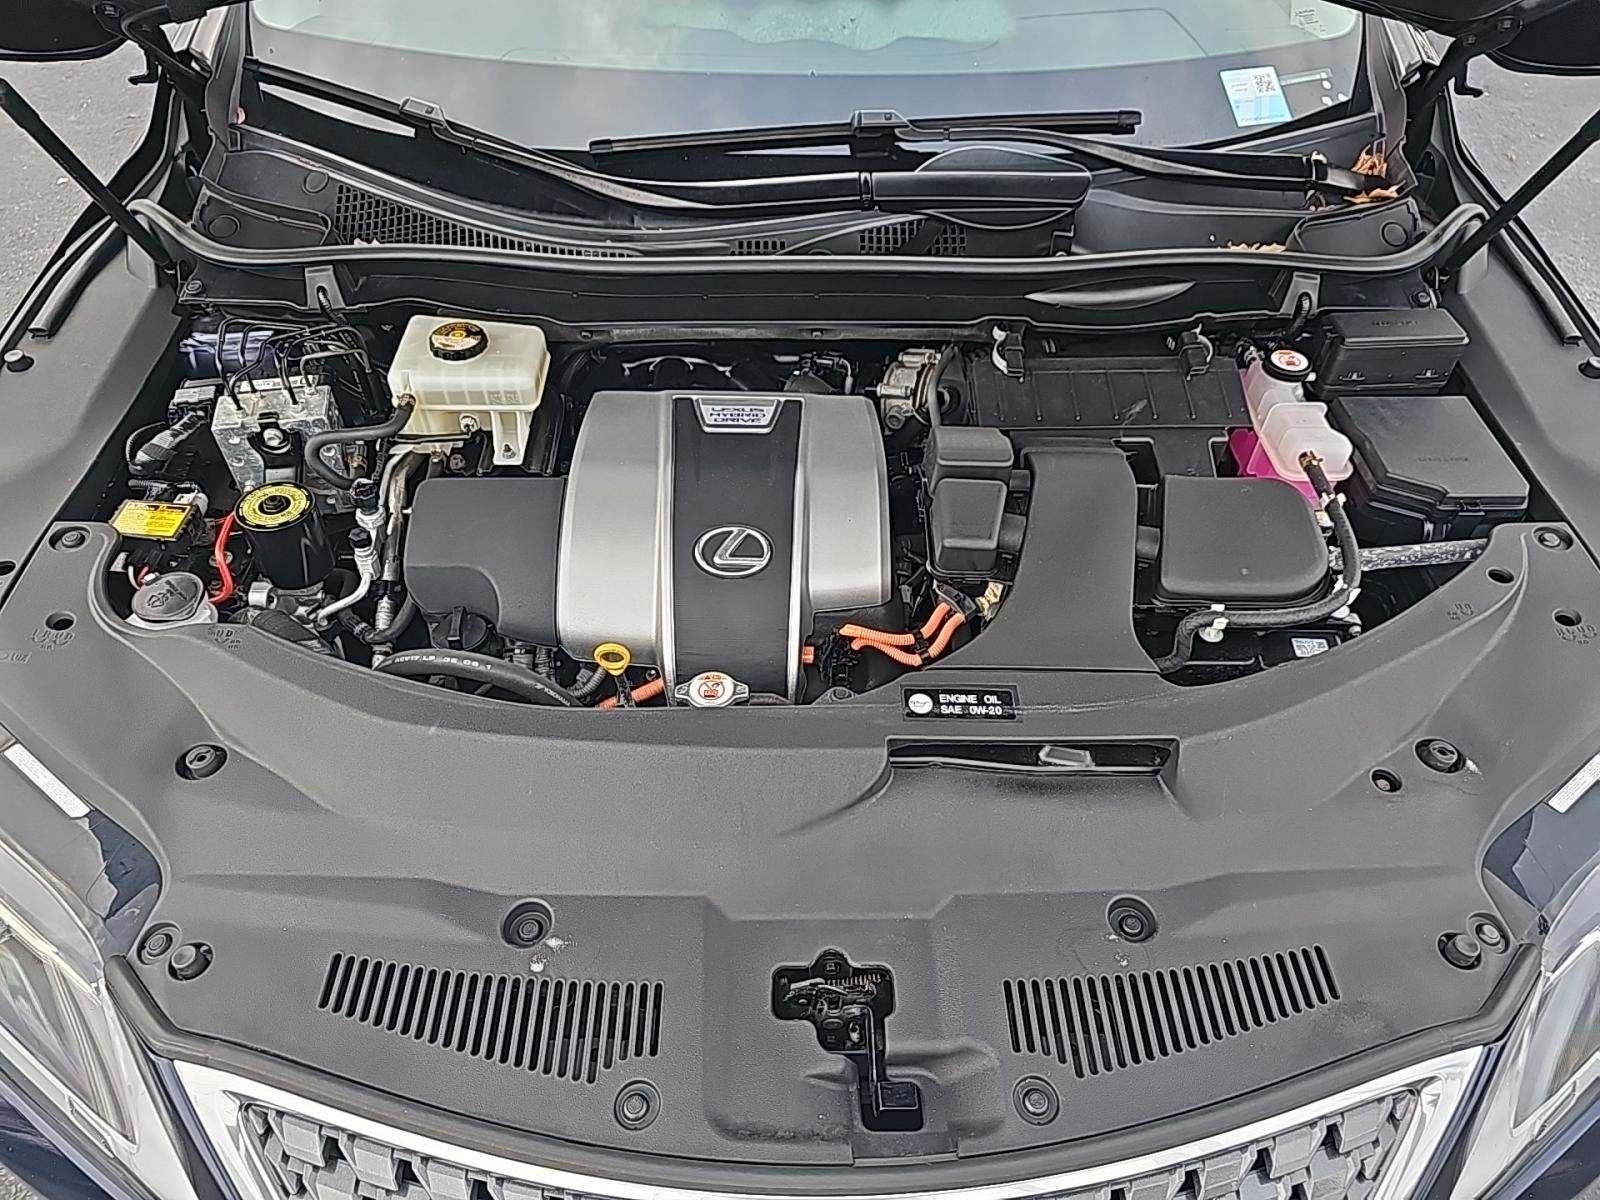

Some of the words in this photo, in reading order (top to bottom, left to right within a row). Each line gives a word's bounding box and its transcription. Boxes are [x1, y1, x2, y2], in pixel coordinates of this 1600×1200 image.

[939, 693, 978, 704] ENGINE
[983, 694, 1002, 705] OIL
[940, 705, 963, 715] SAE
[969, 706, 1003, 716] 0W-20
